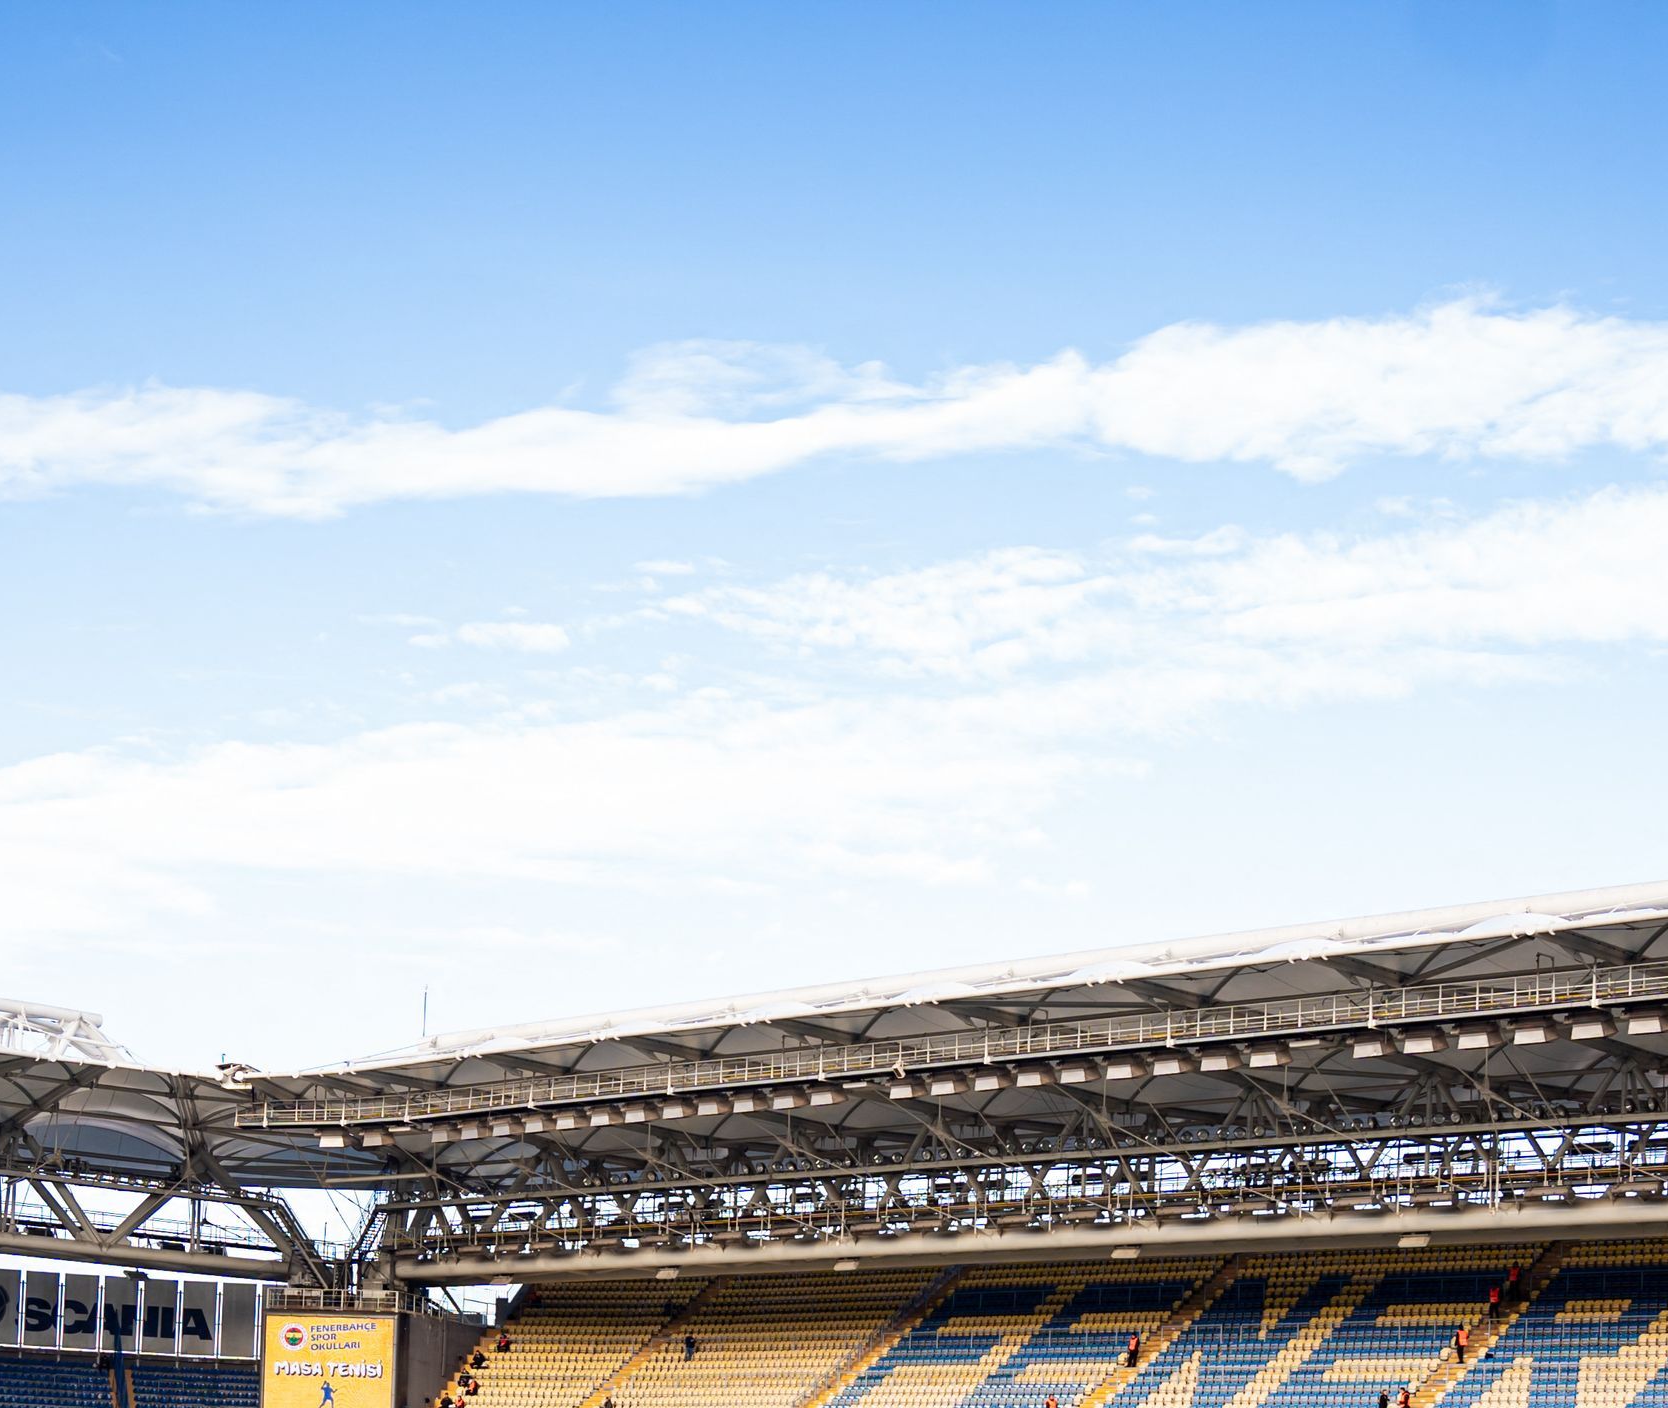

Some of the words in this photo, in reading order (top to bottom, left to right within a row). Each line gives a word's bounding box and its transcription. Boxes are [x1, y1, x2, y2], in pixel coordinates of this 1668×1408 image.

[14, 1297, 212, 1340] SCANIA
[310, 1322, 377, 1333] FENERBAHÇE
[311, 1333, 337, 1341] SPOR
[310, 1341, 361, 1351] OKULLARI
[274, 1361, 323, 1377] MASA
[327, 1360, 383, 1379] TENİSİ
